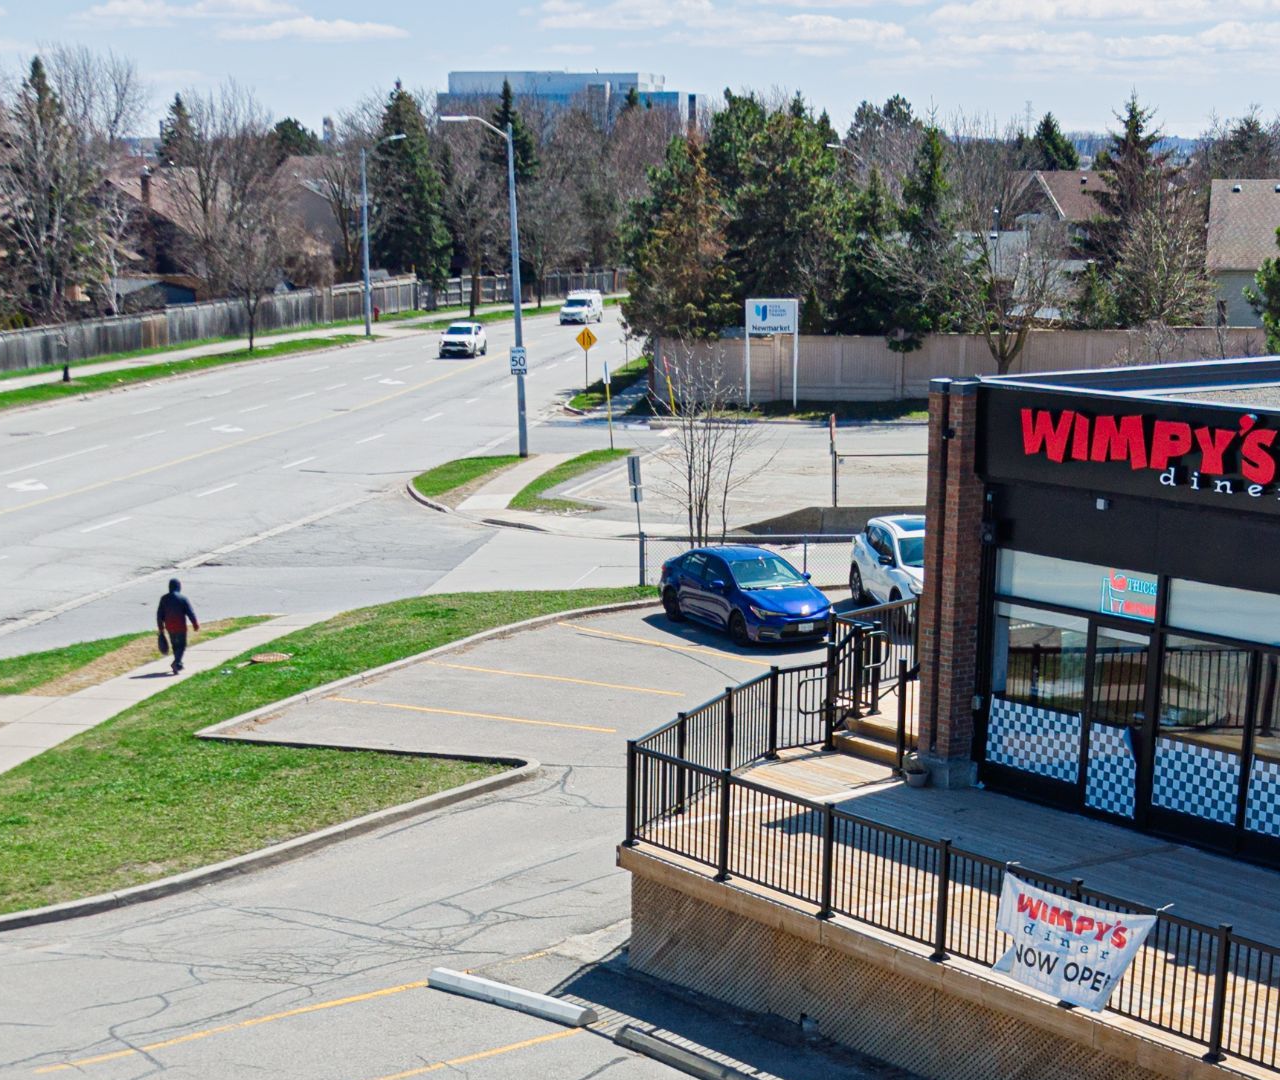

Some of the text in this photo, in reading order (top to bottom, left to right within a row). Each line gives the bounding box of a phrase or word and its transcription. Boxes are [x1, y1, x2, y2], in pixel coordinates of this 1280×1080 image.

[511, 356, 526, 367] 50
[1021, 408, 1277, 485] WIMPY'S
[1127, 578, 1157, 596] THICK
[1017, 893, 1128, 949] WIMPY'S
[1023, 923, 1109, 960] diner
